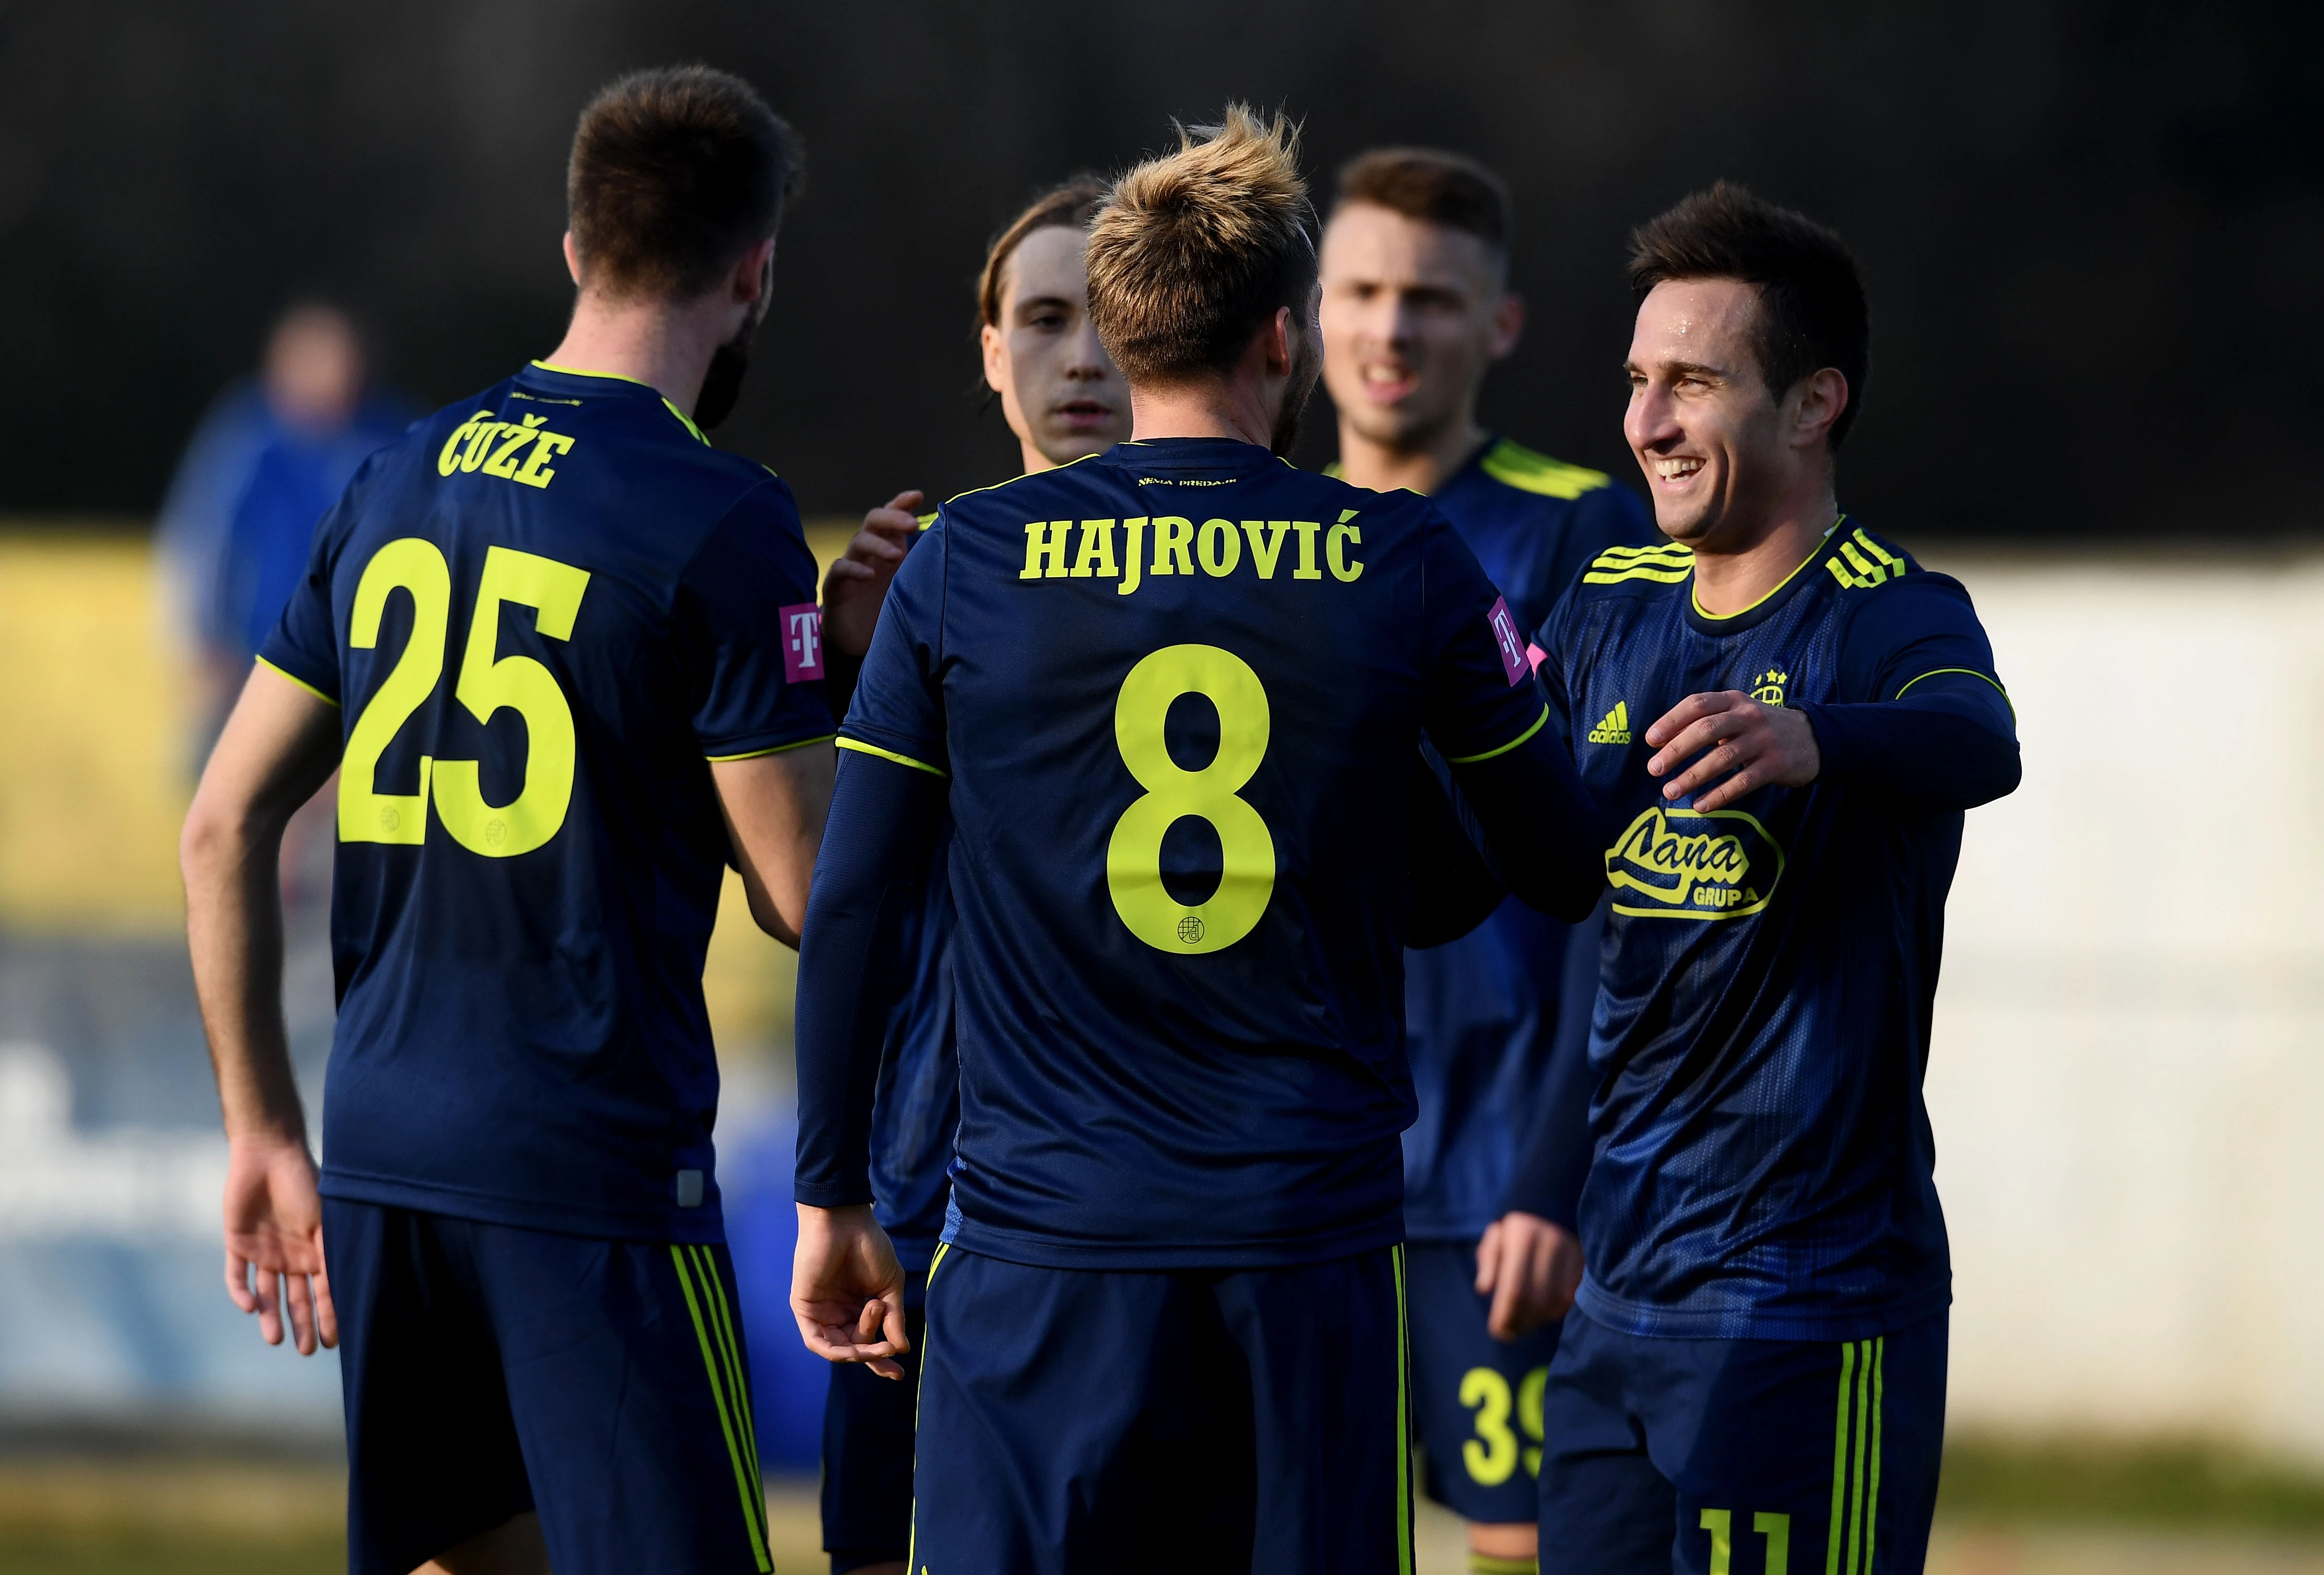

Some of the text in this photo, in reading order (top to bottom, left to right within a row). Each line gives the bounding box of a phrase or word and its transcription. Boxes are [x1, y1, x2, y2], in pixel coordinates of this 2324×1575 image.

[438, 409, 575, 489] ĆUŽE
[1019, 509, 1364, 595] HAJROVIĆ
[338, 537, 591, 857] 25
[1588, 730, 1631, 744] adidas
[1107, 643, 1275, 954] 8
[1608, 812, 1742, 890] Lana
[1693, 886, 1759, 907] GRUPA
[1700, 1508, 1789, 1575] 11
